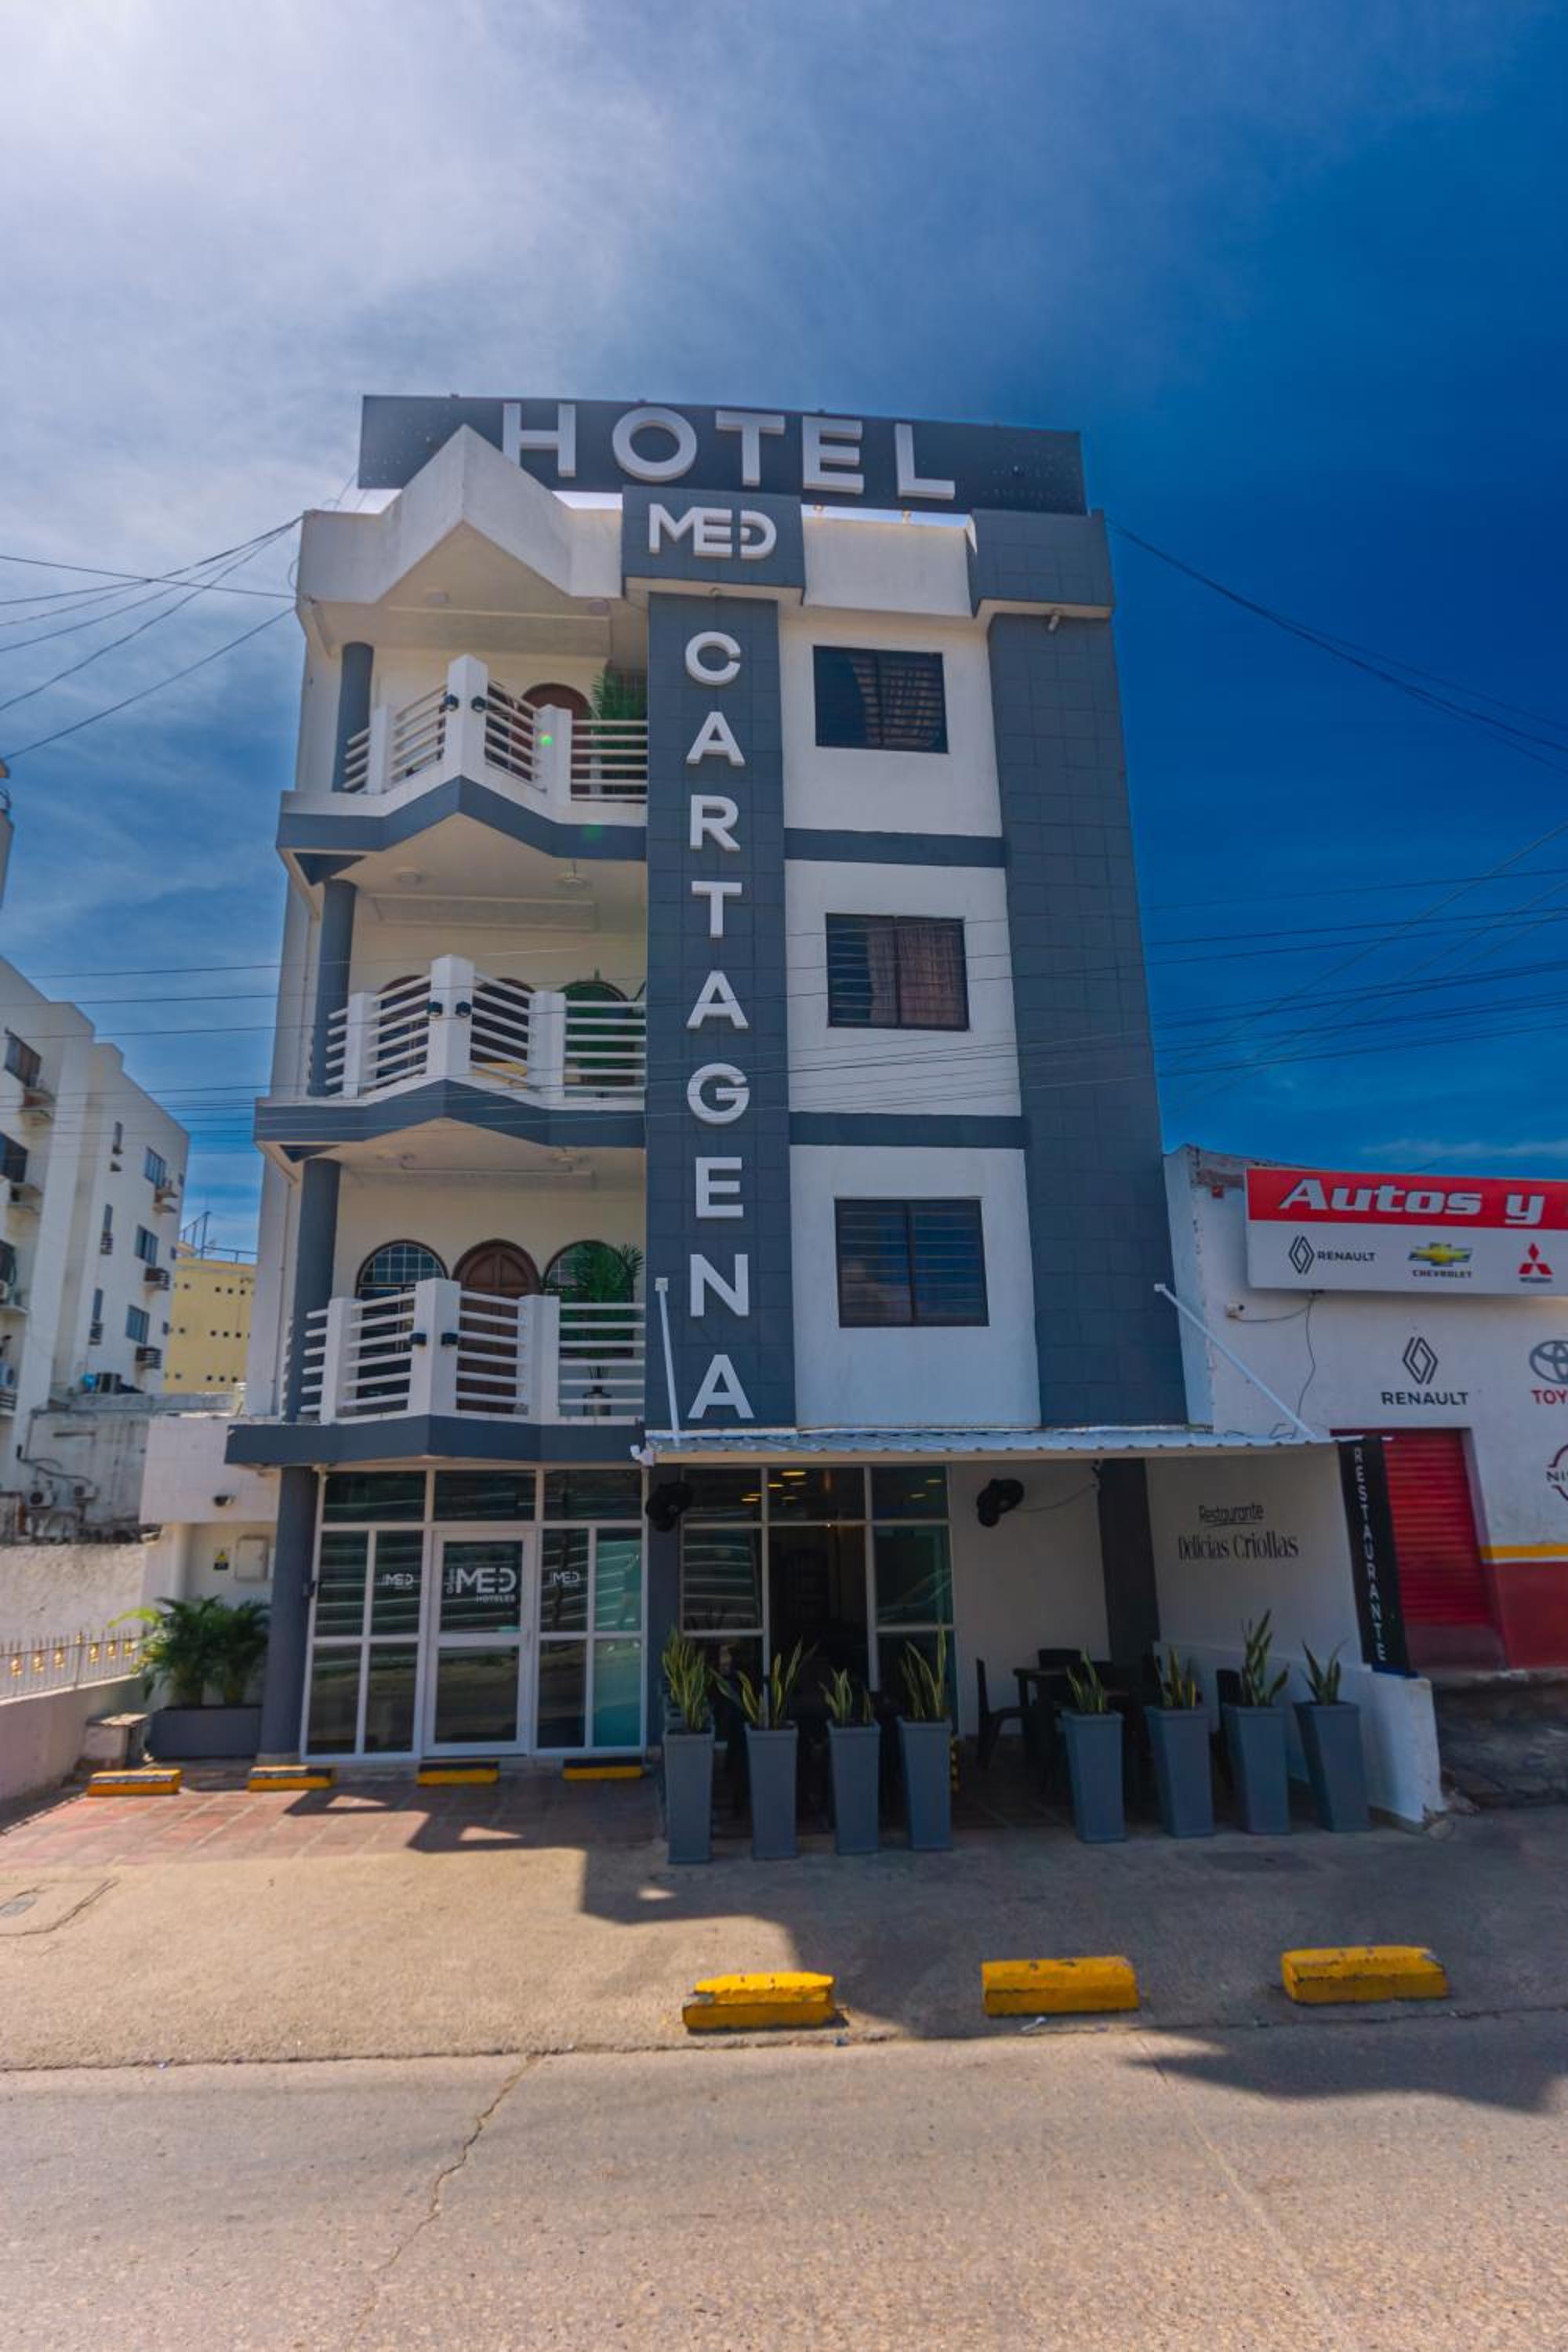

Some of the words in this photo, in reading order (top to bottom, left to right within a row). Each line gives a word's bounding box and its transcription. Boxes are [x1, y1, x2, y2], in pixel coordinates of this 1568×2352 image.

[503, 402, 956, 501] HOTEL
[649, 503, 778, 560] MED
[684, 630, 755, 1419] CARTAGENA
[1279, 1178, 1483, 1215] Autos
[1504, 1194, 1545, 1225] y
[1317, 1250, 1375, 1262] RENAULT
[1412, 1269, 1472, 1279] CHEVROLET
[1381, 1391, 1468, 1406] RENAULT
[1545, 1470, 1568, 1483] NI
[1232, 1529, 1299, 1559] Criollas
[1354, 1446, 1387, 1662] RESTAURANTE
[456, 1567, 517, 1594] MED
[553, 1571, 581, 1584] MED
